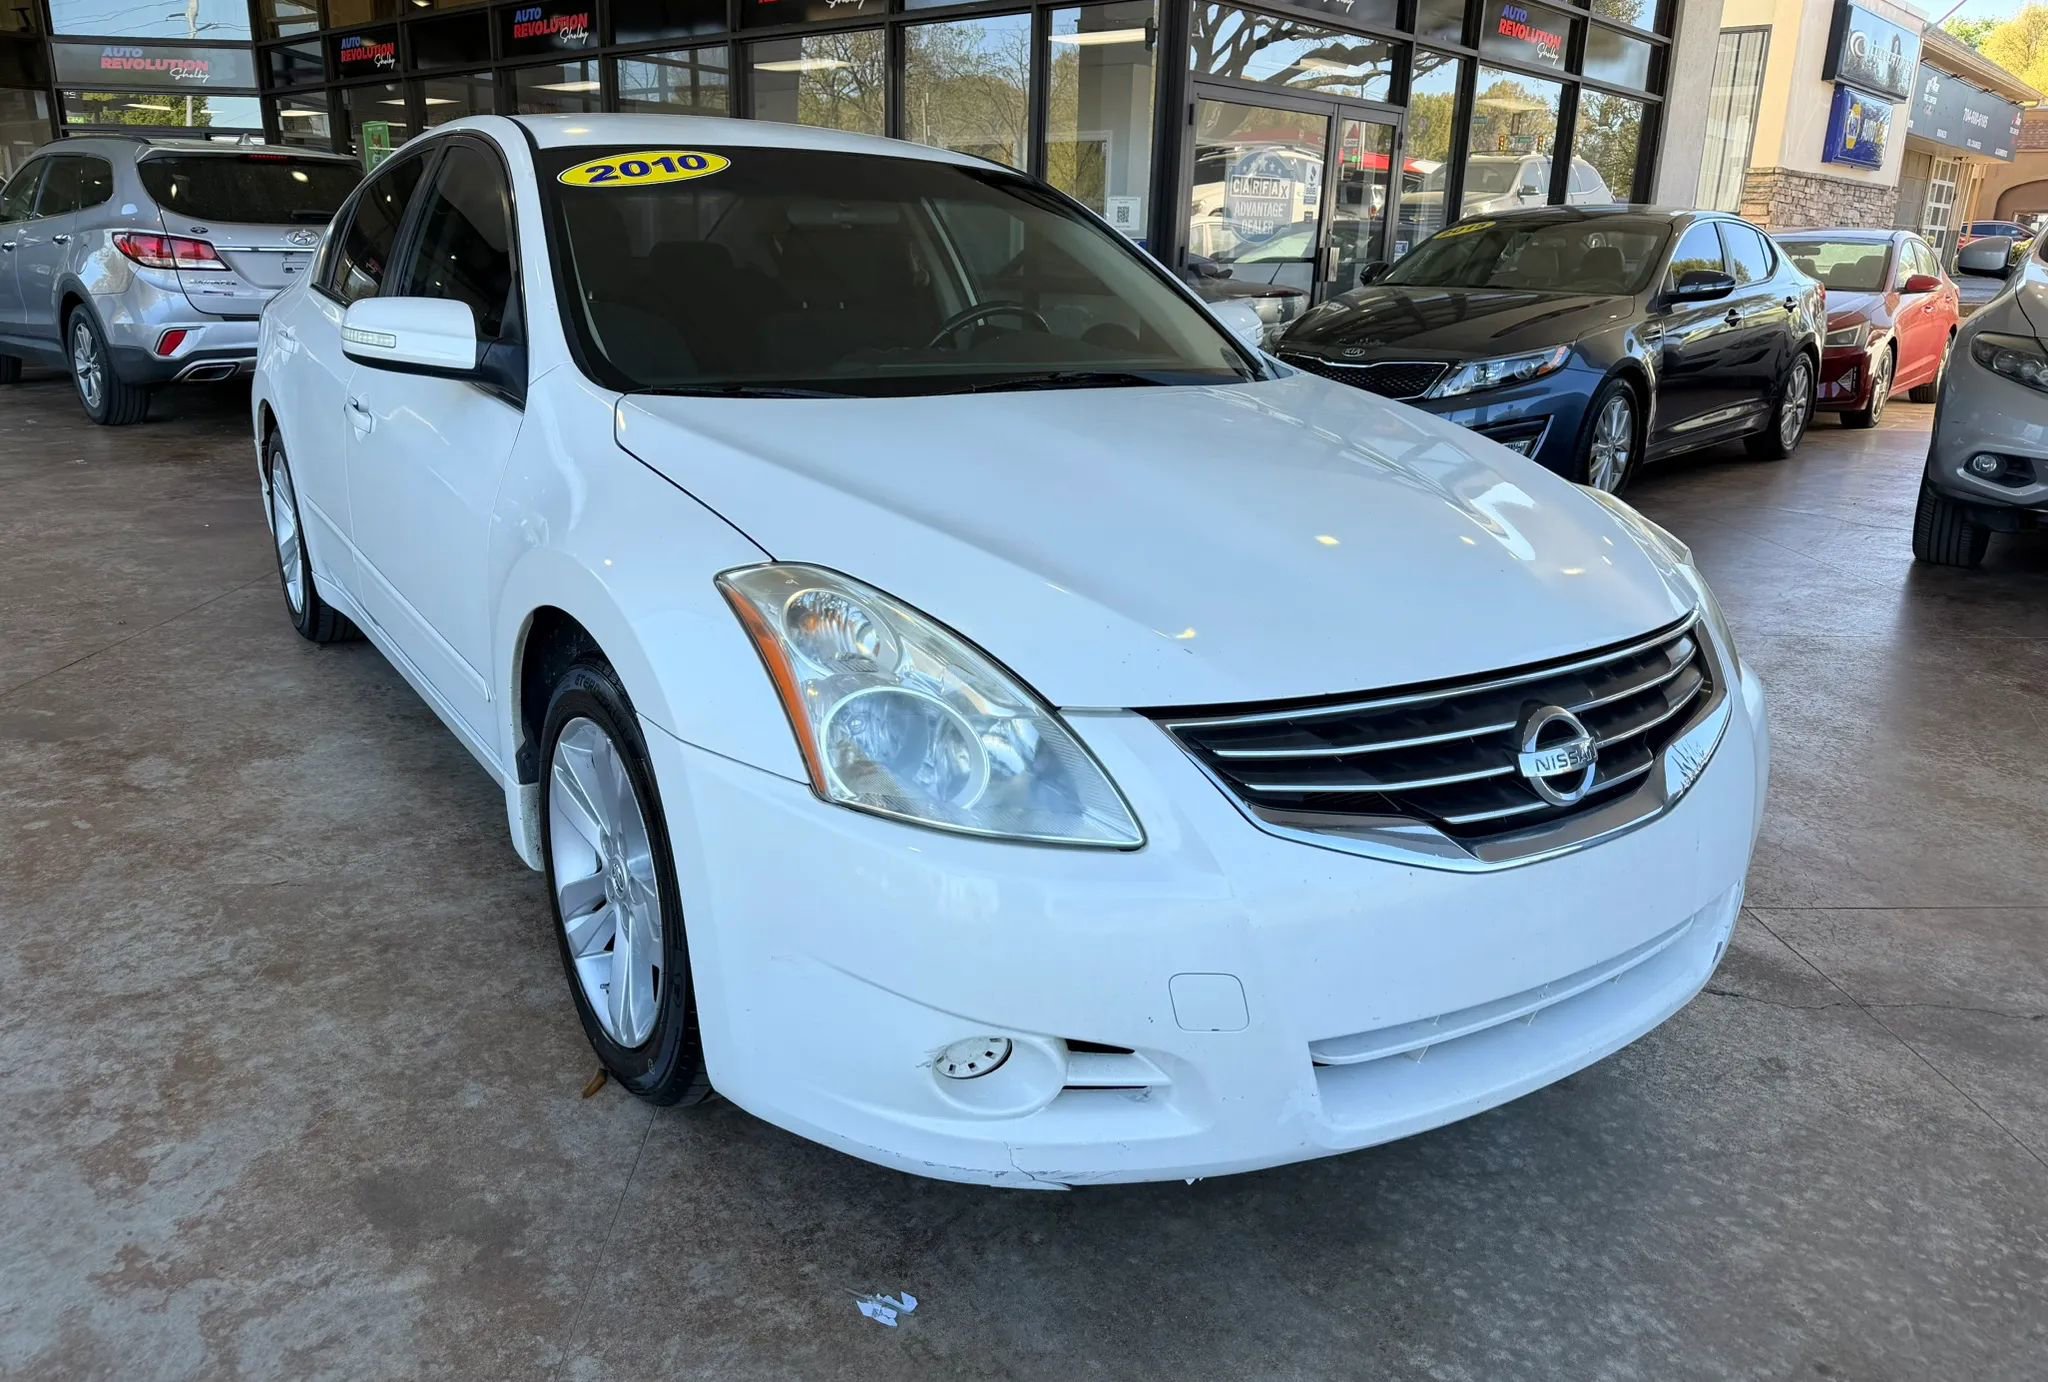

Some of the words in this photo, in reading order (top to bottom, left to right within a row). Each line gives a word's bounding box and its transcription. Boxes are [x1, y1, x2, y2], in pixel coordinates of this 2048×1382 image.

[515, 7, 542, 23] AUTO
[1501, 4, 1528, 22] AUTO
[514, 13, 588, 38] REVOLUTION
[559, 25, 589, 44] Shelby
[1498, 18, 1562, 48] REVOLUTION
[341, 36, 361, 49] AUTO
[102, 47, 143, 57] AUTO
[341, 42, 395, 62] REVOLUTION
[1536, 42, 1560, 65] Shelby
[101, 58, 208, 71] REVOLUTION
[374, 54, 396, 69] Shelby
[169, 67, 210, 83] Shelby
[585, 155, 708, 183] 2010
[1232, 177, 1289, 199] CARFAX
[1234, 201, 1284, 217] ADVANTAGE
[1241, 219, 1274, 235] DEALER
[1535, 742, 1597, 773] NISSAN
